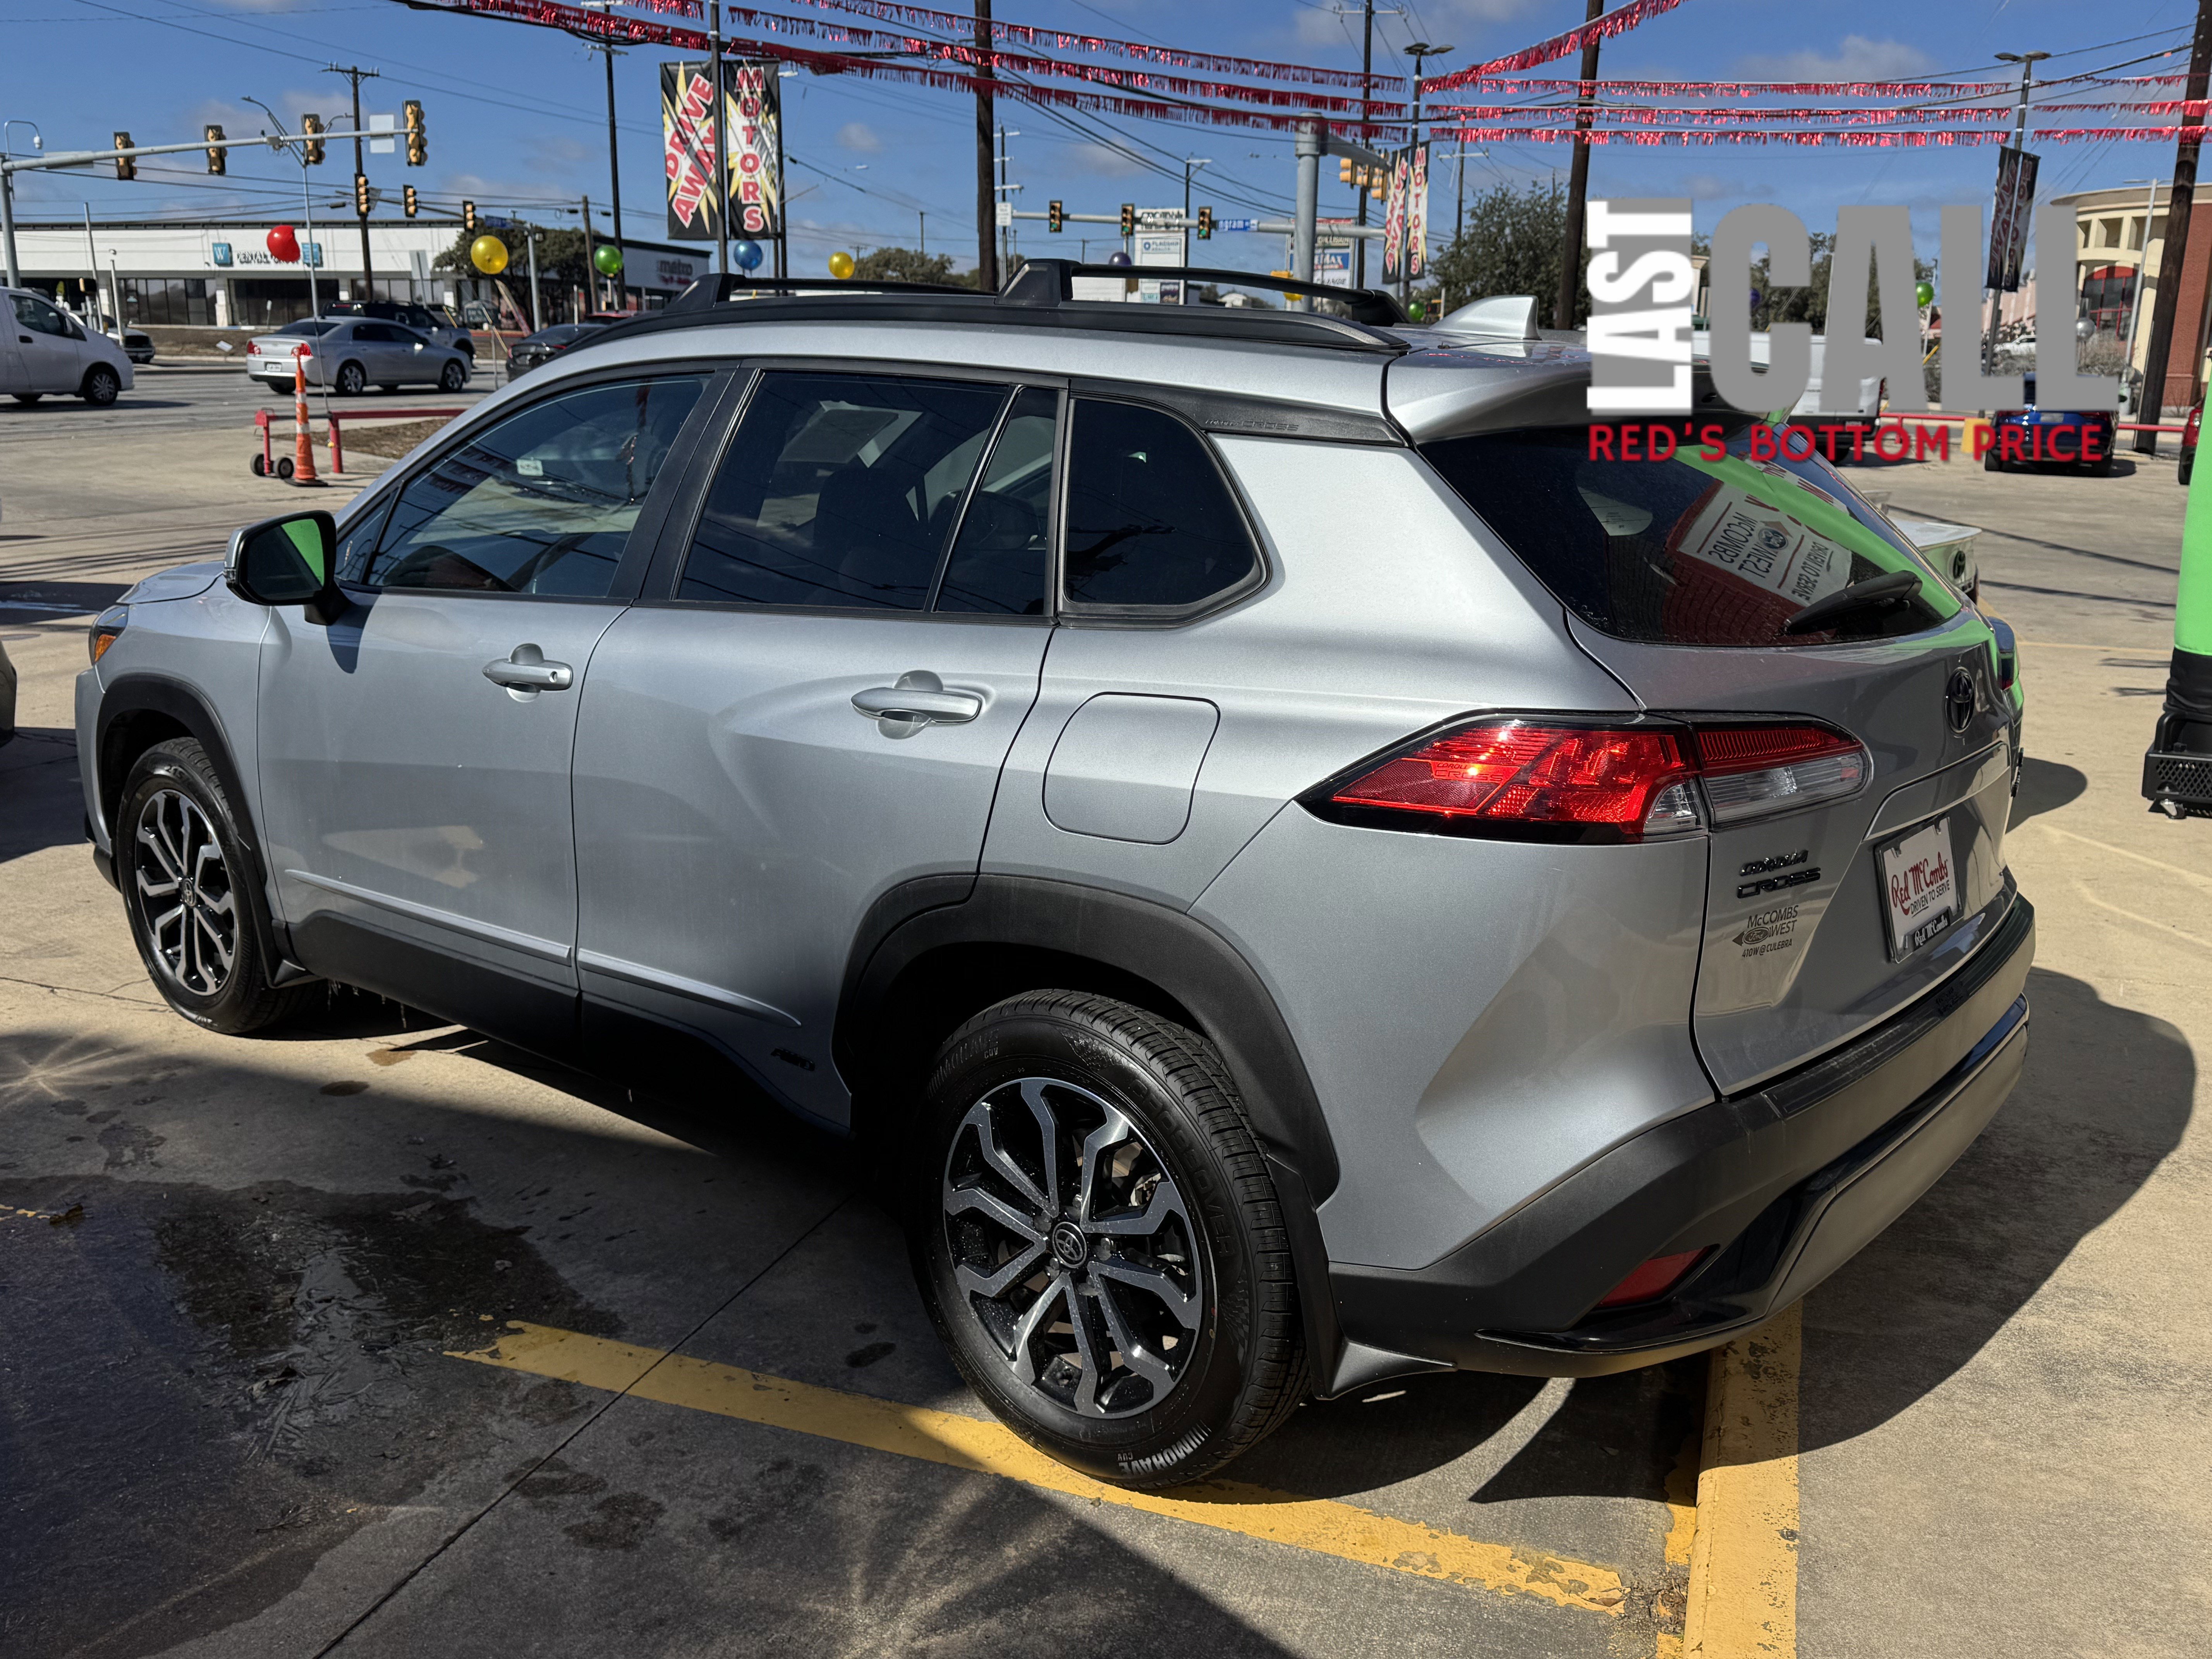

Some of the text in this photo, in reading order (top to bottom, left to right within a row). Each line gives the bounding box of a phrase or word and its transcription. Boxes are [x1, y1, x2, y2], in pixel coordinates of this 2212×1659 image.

[666, 73, 714, 181] DRIVE
[735, 66, 764, 232] MOTORS
[672, 125, 716, 228] AWAY
[1219, 220, 1244, 232] ngram
[1410, 146, 1426, 275] MOTORS
[1737, 867, 1821, 899] CROSS
[1891, 852, 1949, 915] Red McCombs
[1910, 879, 1950, 915] DRIVEN TO SERVE
[1747, 905, 1799, 928] McCOMBS
[1769, 919, 1797, 938] WEST
[1118, 1437, 1194, 1475] MOHAVE
